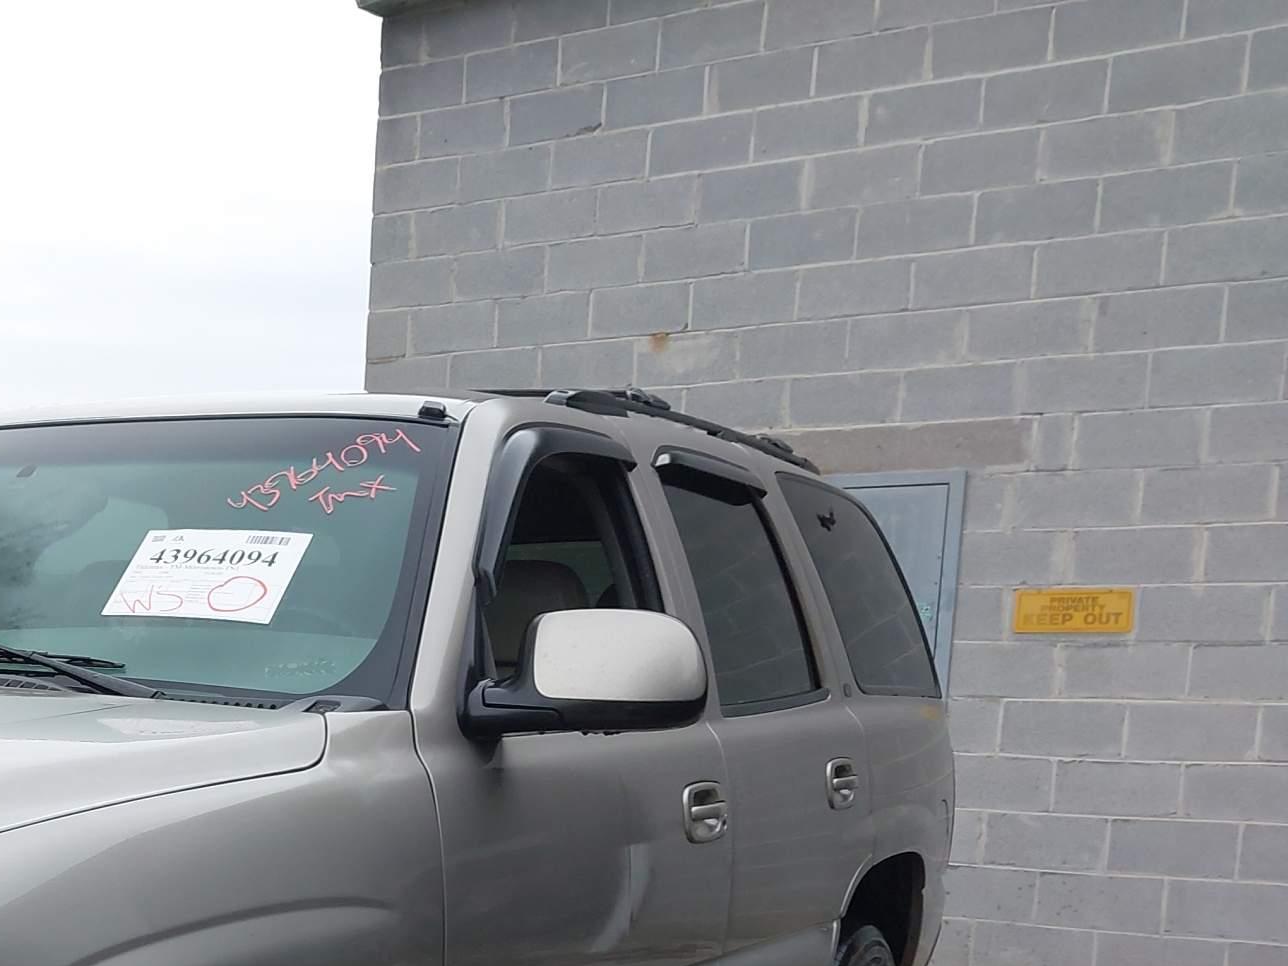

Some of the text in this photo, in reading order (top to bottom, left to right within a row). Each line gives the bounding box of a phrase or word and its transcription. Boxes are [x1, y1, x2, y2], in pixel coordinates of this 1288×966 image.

[149, 548, 279, 567] 43964094
[1049, 595, 1100, 606] PRIVATE
[1083, 611, 1124, 625] OUT
